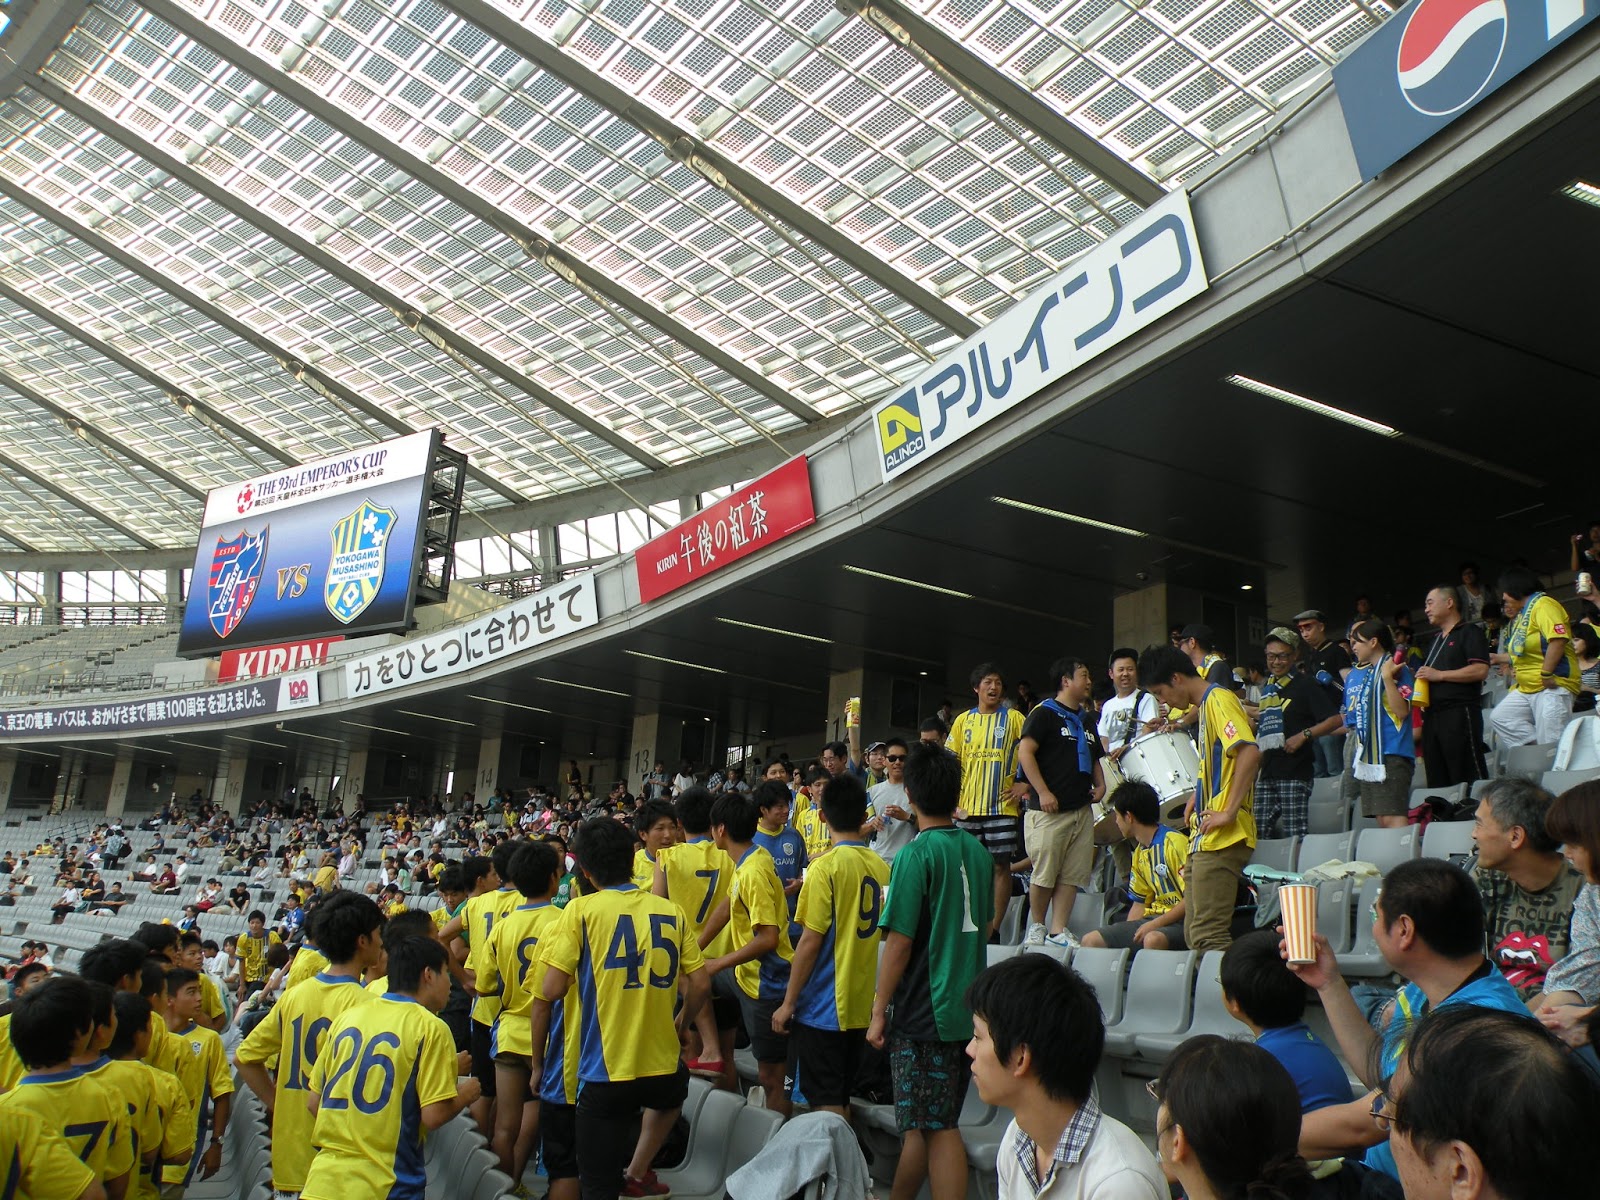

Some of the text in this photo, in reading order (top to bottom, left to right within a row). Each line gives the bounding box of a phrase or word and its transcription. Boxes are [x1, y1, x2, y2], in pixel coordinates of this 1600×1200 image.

[921, 213, 1192, 442] アルインコ
[886, 436, 925, 471] ALINCO
[257, 449, 388, 498] THE 93rd EMPEROR'S CUP
[219, 546, 236, 556] ESTD
[655, 490, 769, 575] KIRIN 午後の紅茶
[332, 560, 380, 576] MUSASHINO
[335, 549, 380, 565] YOKOGAWA
[276, 563, 312, 601] VS
[227, 580, 256, 629] 1999
[354, 584, 583, 693] 力をひとつに合わせて
[236, 642, 324, 681] KIRIN
[289, 679, 309, 700] 100
[964, 728, 972, 744] 3
[480, 767, 493, 789] 14
[635, 749, 650, 774] 13
[113, 782, 125, 797] 17
[229, 781, 240, 798] 16
[348, 777, 360, 795] 15
[803, 823, 813, 838] 19
[695, 868, 719, 924] 7
[856, 875, 880, 940] 9
[961, 860, 979, 933] 1
[604, 914, 679, 990] 45
[320, 1026, 401, 1115] 26
[63, 1120, 110, 1163] 7
